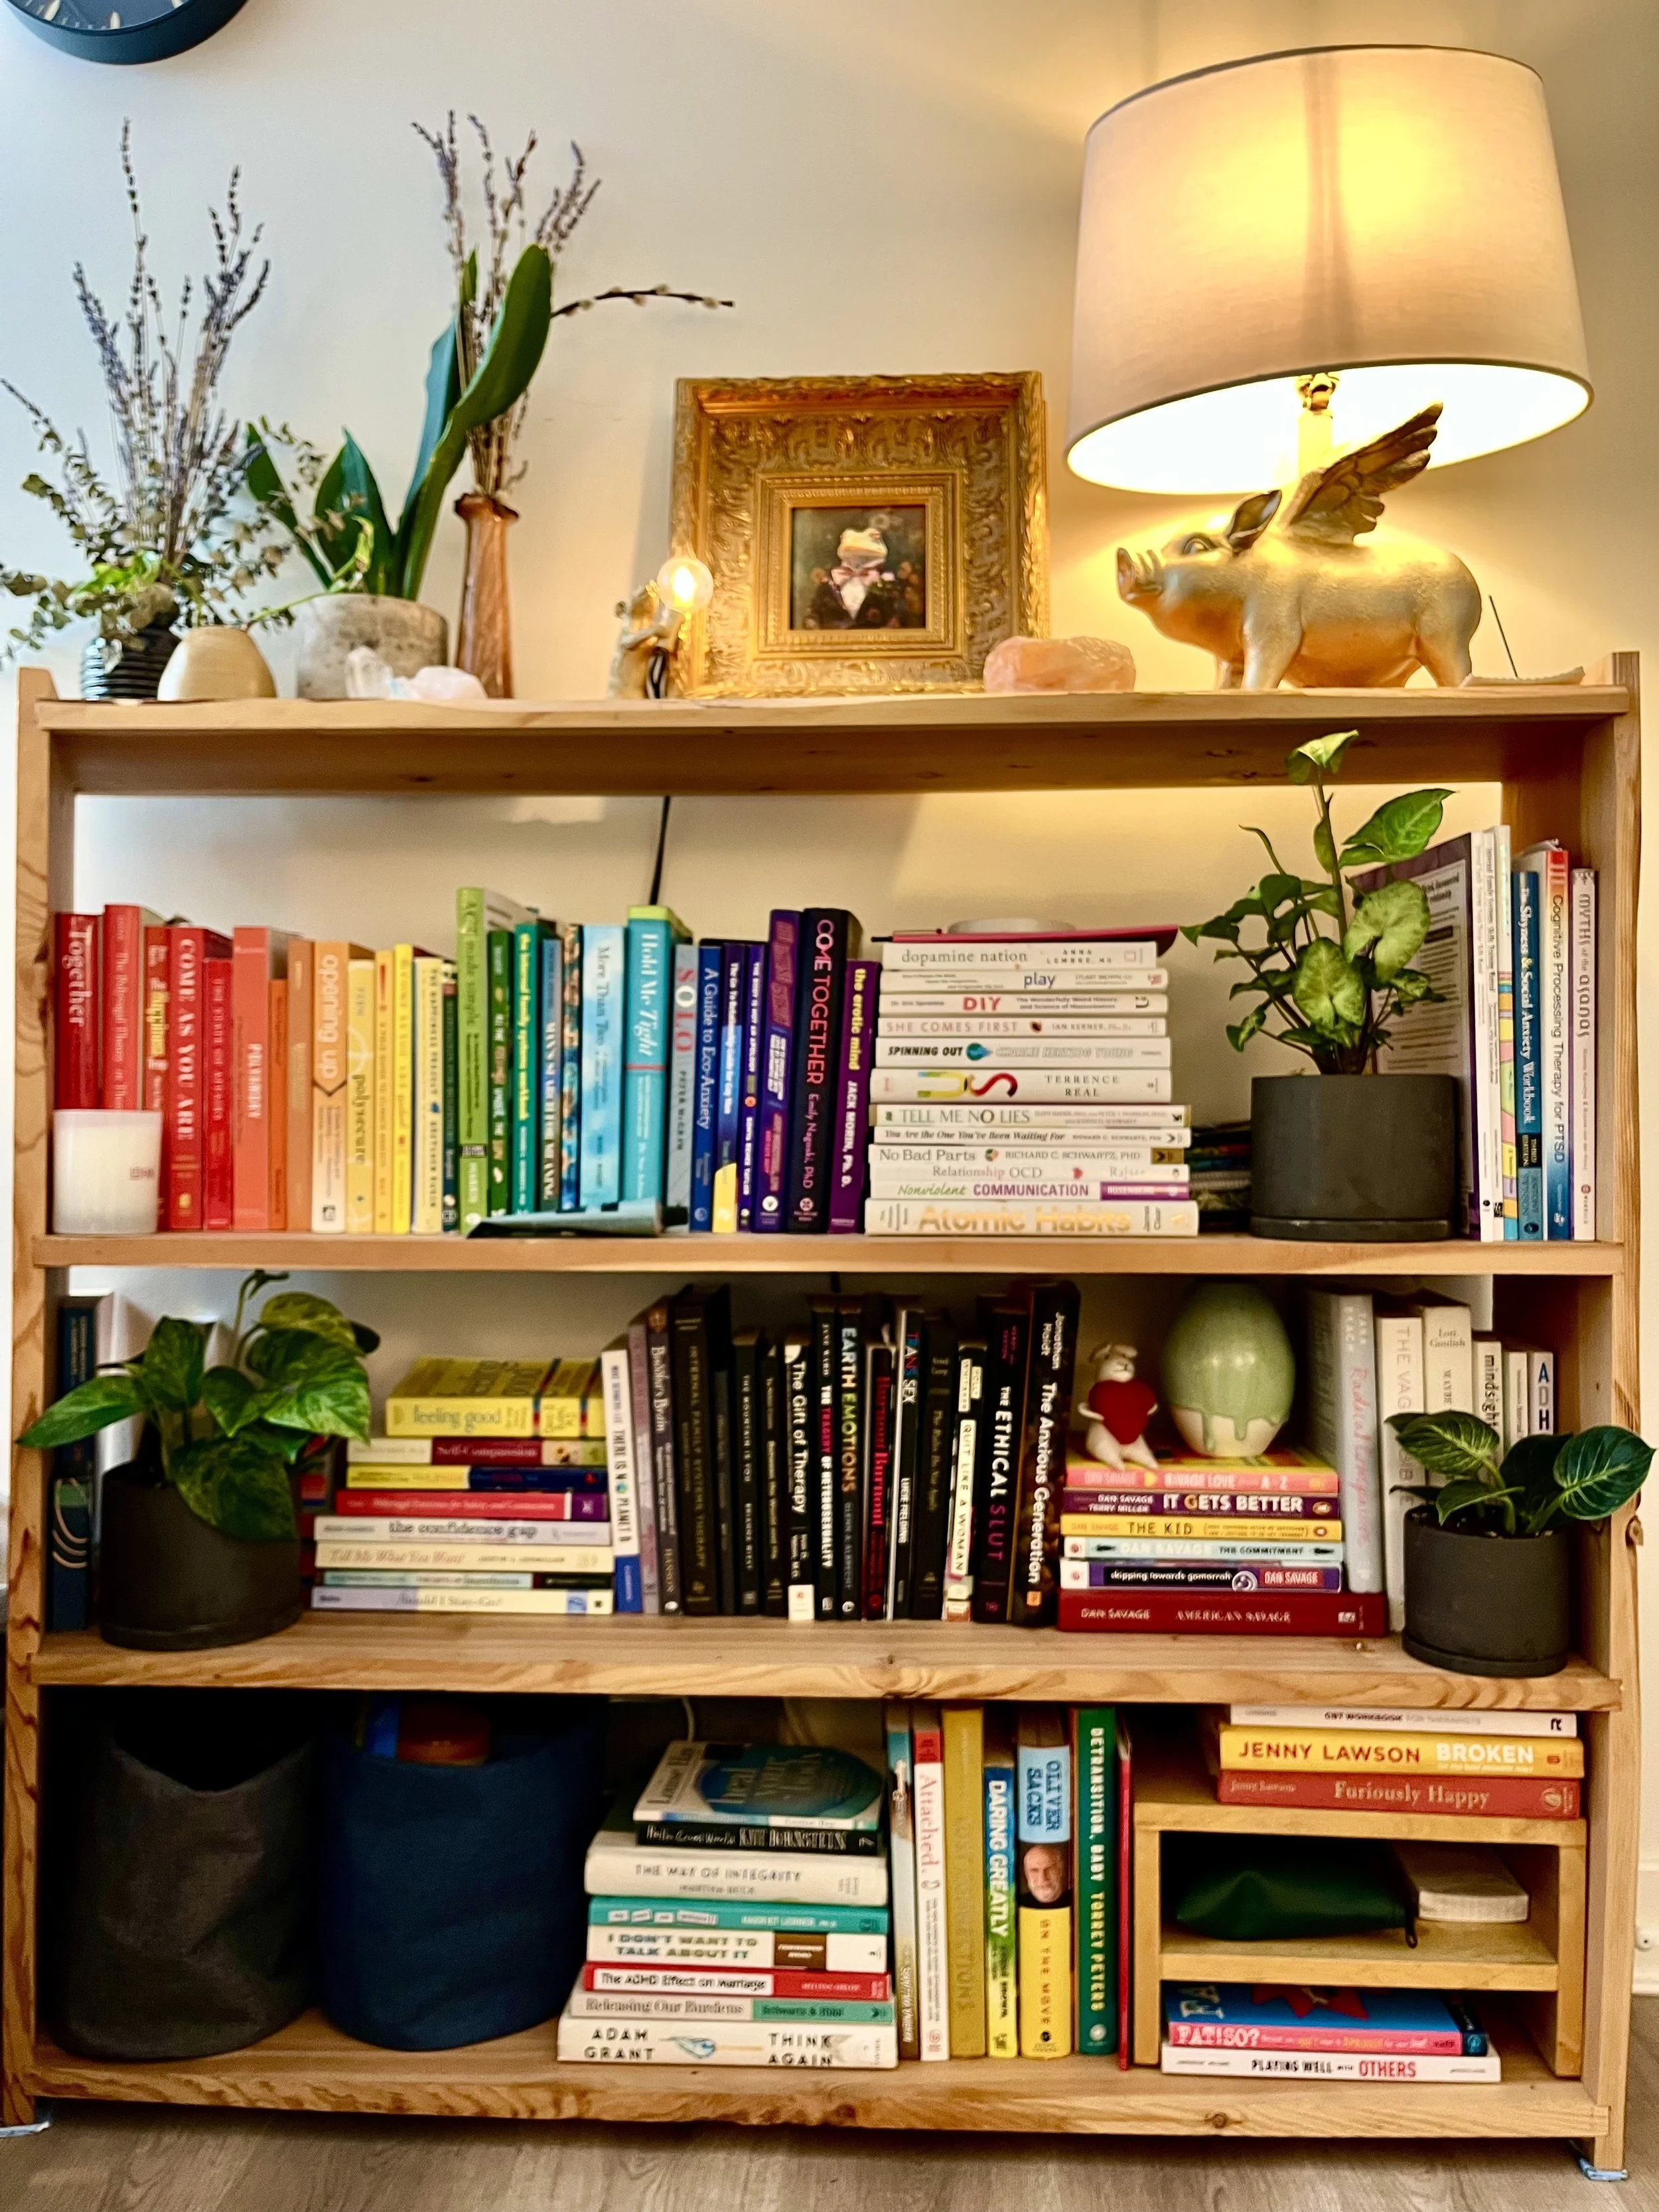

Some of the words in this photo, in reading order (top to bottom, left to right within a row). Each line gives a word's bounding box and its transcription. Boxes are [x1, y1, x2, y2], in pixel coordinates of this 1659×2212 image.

[1518, 905, 1532, 954] Shyness
[1551, 895, 1563, 958] Cognitive
[640, 933, 659, 975] Hold
[814, 920, 834, 970] COME
[902, 950, 974, 966] dopamine
[981, 950, 1027, 962] nation
[62, 926, 92, 1027] Together
[179, 940, 196, 1001] COME
[597, 947, 609, 978] More
[705, 968, 719, 980] A
[1520, 957, 1532, 969] &
[640, 980, 657, 1005] Me
[853, 968, 866, 991] the
[1025, 972, 1056, 989] play
[1520, 971, 1533, 1008] Social
[319, 955, 342, 1043] opening
[597, 982, 609, 1016] Than
[674, 968, 697, 1053] SOLO
[704, 984, 717, 1025] Guide
[851, 995, 865, 1034] erotic
[963, 997, 1001, 1011] DIY
[1551, 963, 1563, 1038] Processing
[179, 1009, 196, 1037] AS
[596, 1021, 609, 1045] Two
[634, 1009, 658, 1056] Tight
[703, 1029, 713, 1043] to
[807, 976, 831, 1084] TOGETHER
[887, 1022, 913, 1033] SHE
[921, 1022, 971, 1033] COMES
[979, 1022, 1019, 1033] FIRST
[1520, 1011, 1534, 1059] Anxiety
[179, 1044, 196, 1088] YOU
[319, 1051, 342, 1079] up
[848, 1037, 862, 1070] mind
[888, 1047, 938, 1056] SPINNING
[942, 1047, 963, 1056] OUT
[1550, 1043, 1563, 1098] Therapy
[697, 1047, 715, 1129] Eco-Anxiety
[1065, 1088, 1099, 1096] REAL
[1522, 1062, 1536, 1124] Workbook
[179, 1096, 195, 1140] ARE
[352, 1074, 374, 1164] polysecure
[900, 1110, 934, 1123] TELL
[940, 1110, 962, 1123] ME
[968, 1110, 995, 1123] NO
[1000, 1110, 1030, 1123] LIES
[1553, 1102, 1563, 1120] for
[958, 1131, 986, 1140] You've
[1014, 1131, 1047, 1142] Waiting
[1554, 1124, 1565, 1163] PTSD
[879, 1149, 899, 1161] No
[902, 1149, 931, 1161] Bad
[936, 1149, 975, 1161] Parts
[933, 1167, 1005, 1180] Relationship
[1009, 1167, 1043, 1178] OCD
[898, 1183, 966, 1195] Nonviolent
[974, 1184, 1089, 1196] COMMUNICATION
[918, 1206, 1025, 1232] Atomic
[1035, 1206, 1131, 1232] Habits
[1041, 1322, 1053, 1356] Haidt
[1051, 1312, 1065, 1371] Jonathan
[1439, 1327, 1457, 1337] Lori
[841, 1327, 857, 1388] EARTH
[905, 1333, 919, 1376] TRANS
[651, 1345, 671, 1396] Buddha's
[792, 1361, 806, 1391] The
[820, 1385, 833, 1406] THE
[902, 1379, 918, 1404] SEX
[999, 1386, 1011, 1406] THE
[1041, 1382, 1058, 1414] The
[1482, 1355, 1500, 1427] mindsight
[413, 1404, 461, 1427] feeling
[465, 1408, 501, 1433] good
[653, 1398, 670, 1433] Brain
[792, 1395, 808, 1425] Gift
[792, 1430, 806, 1445] of
[820, 1407, 832, 1453] TRAGEDY
[841, 1394, 857, 1492] EMOTIONS
[963, 1425, 972, 1456] QUIT
[437, 1445, 538, 1459] Self-Compassion
[820, 1455, 832, 1470] OF
[990, 1410, 1013, 1498] ETHICAL
[1035, 1416, 1054, 1483] Anxious
[791, 1450, 808, 1514] Therapy
[871, 1451, 890, 1526] Burnout
[960, 1463, 970, 1491] LIKE
[1163, 1494, 1180, 1509] IT
[1184, 1494, 1230, 1511] GETS
[1236, 1495, 1303, 1512] BETTER
[820, 1471, 833, 1569] HETEROSEXUALITY
[987, 1504, 1006, 1562] SLUT
[1028, 1486, 1050, 1584] Generation
[1127, 1522, 1156, 1534] THE
[1164, 1522, 1193, 1535] KID
[956, 1513, 966, 1571] WOMAN
[1111, 1569, 1147, 1581] skipping
[1149, 1572, 1185, 1580] towards
[1188, 1570, 1231, 1582] gomorrah
[1265, 1571, 1283, 1584] DAN
[1285, 1572, 1318, 1584] SAVAGE
[1081, 1608, 1106, 1618] DAN
[1108, 1609, 1151, 1620] SAVAGE
[1175, 1610, 1243, 1621] AMERICAN
[1246, 1611, 1291, 1623] SAVAGE
[1238, 1741, 1312, 1759] JENNY
[1323, 1744, 1420, 1763] LAWSON
[1436, 1743, 1534, 1764] BROKEN
[1027, 1768, 1043, 1825] SACKS
[1046, 1761, 1062, 1832] OLIVER
[1089, 1727, 1104, 1840] DETRANSITION,
[1334, 1780, 1422, 1807] Furiously
[1428, 1785, 1490, 1808] Happy
[919, 1775, 940, 1874] Attached.
[988, 1780, 1008, 1850] DARING
[1090, 1844, 1104, 1881] BABY
[989, 1854, 1009, 1938] GREATLY
[1040, 1919, 1051, 1939] ON
[1090, 1892, 1105, 1949] TORREY
[608, 1933, 614, 1943] I
[619, 1935, 673, 1943] DON'T
[679, 1936, 729, 1945] WANT
[736, 1938, 757, 1947] TO
[666, 1949, 727, 1958] ABOUT
[733, 1950, 749, 1959] IT
[1041, 1947, 1052, 1976] THE
[601, 1972, 621, 1984] The
[624, 1975, 658, 1985] ADHD
[661, 1975, 695, 1987] Effect
[698, 1978, 715, 1988] on
[717, 1977, 766, 1991] Marriage
[1090, 1953, 1105, 2011] PETERS
[1041, 1983, 1051, 2024] MOVE
[592, 2028, 649, 2041] ADAM
[768, 2033, 831, 2049] THINK
[584, 2046, 655, 2060] GRANT
[768, 2053, 833, 2066] AGAIN
